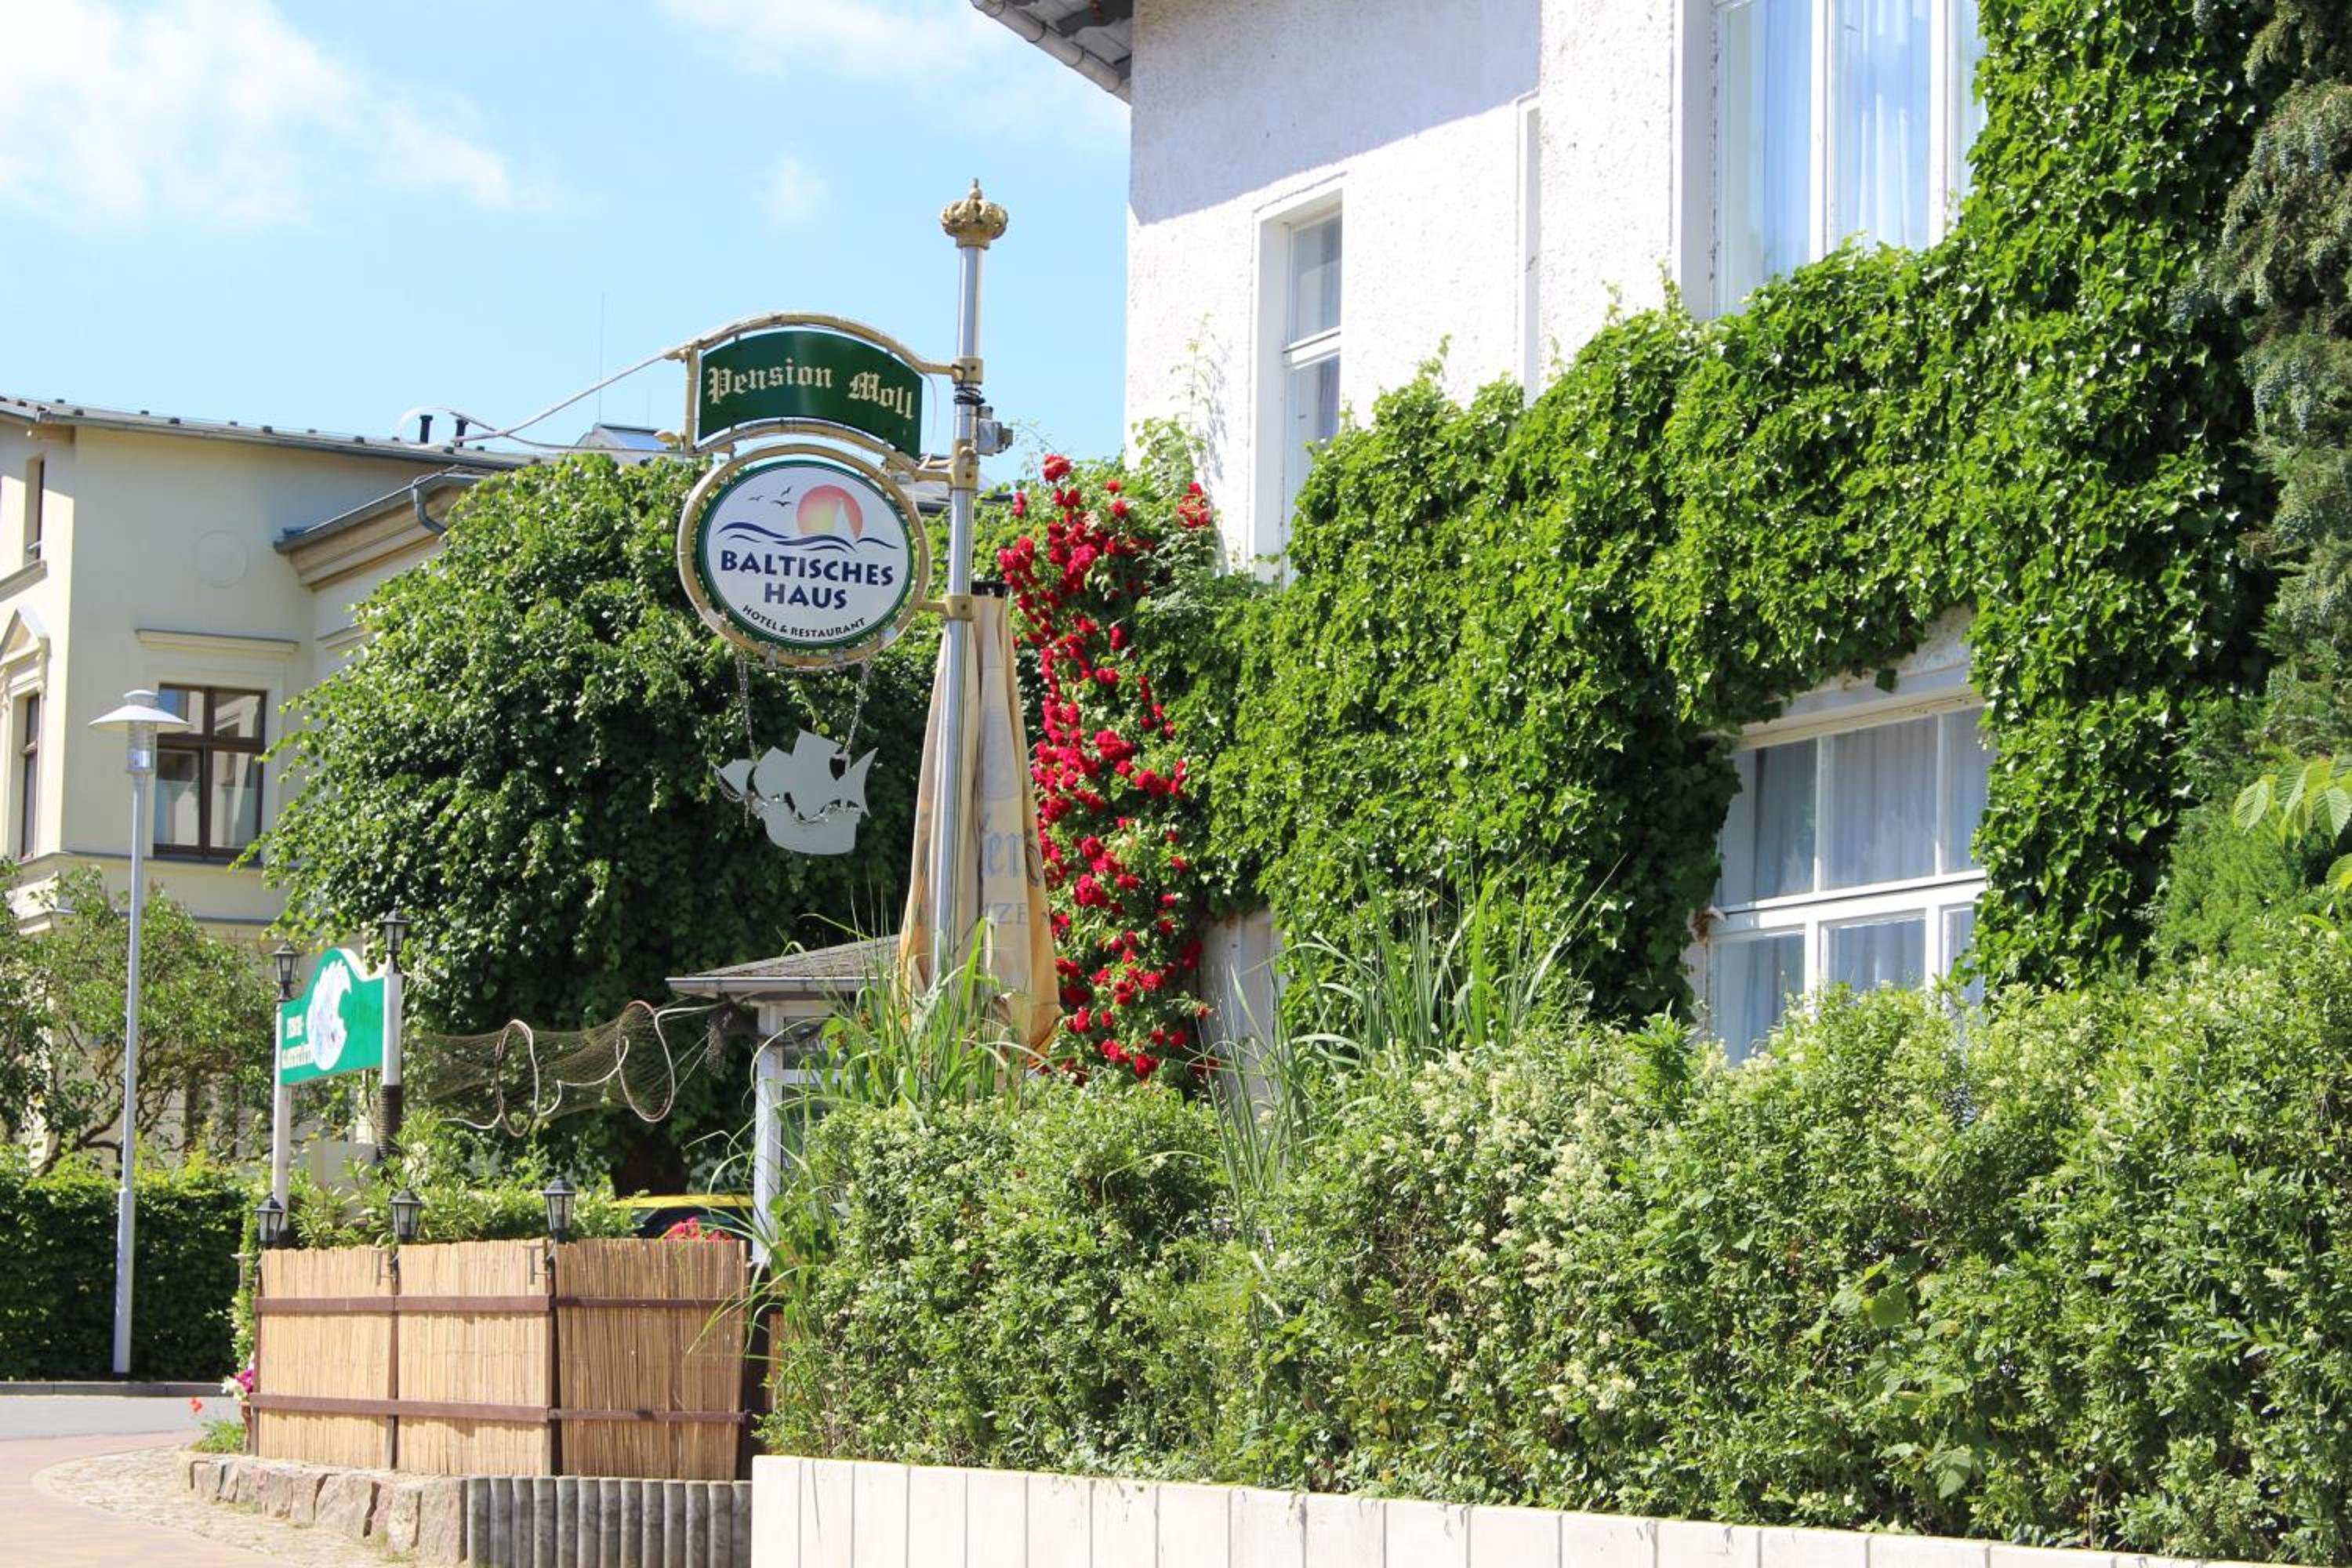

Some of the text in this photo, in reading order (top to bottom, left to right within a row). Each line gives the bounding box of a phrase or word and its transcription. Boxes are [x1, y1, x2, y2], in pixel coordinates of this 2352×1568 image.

[708, 357, 914, 419] Pension Moll
[720, 550, 894, 586] BALTISCHES
[764, 582, 848, 610] HAUS
[742, 604, 866, 638] HOTEL & RESTAURANT
